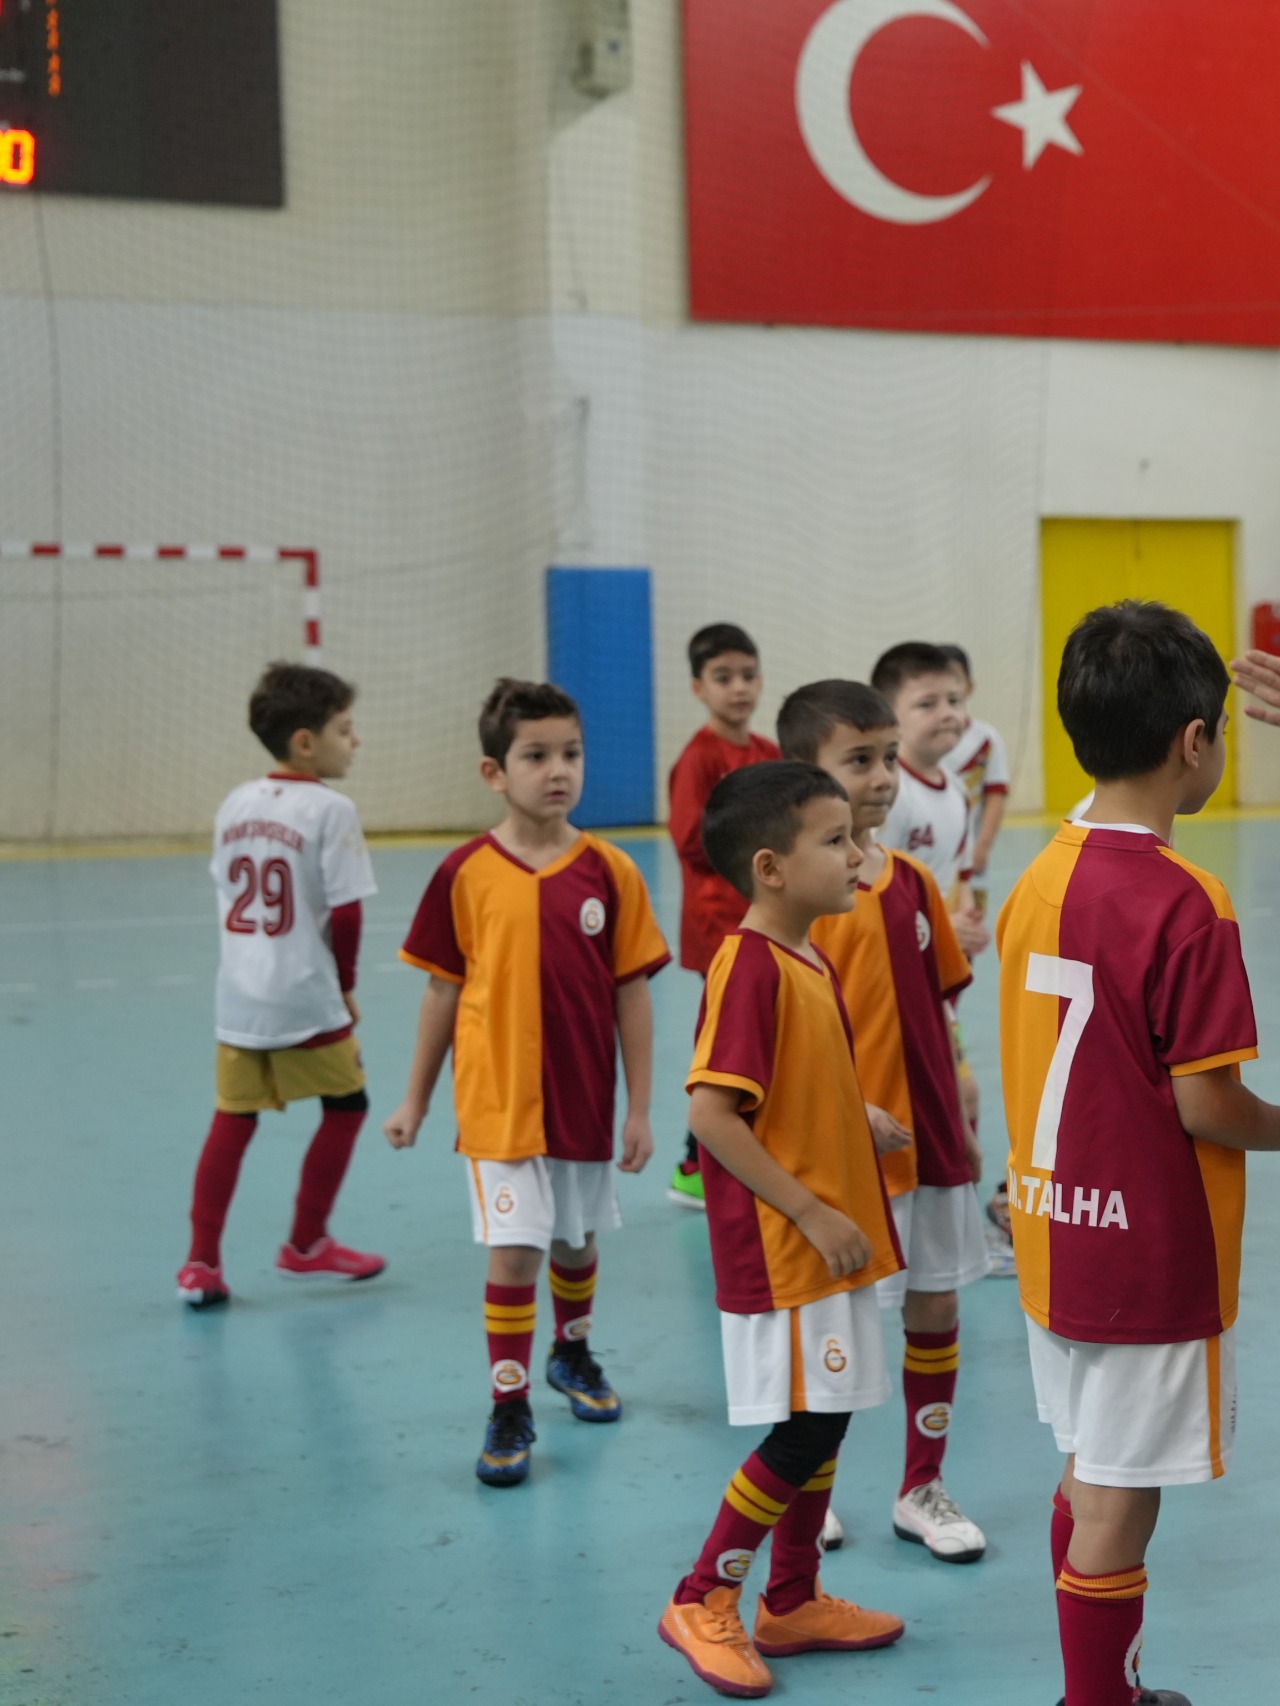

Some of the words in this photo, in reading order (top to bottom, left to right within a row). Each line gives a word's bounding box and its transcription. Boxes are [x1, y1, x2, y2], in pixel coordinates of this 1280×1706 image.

[226, 856, 295, 936] 29
[1025, 952, 1094, 1171] 7
[1008, 1166, 1128, 1231] M.TALHA
